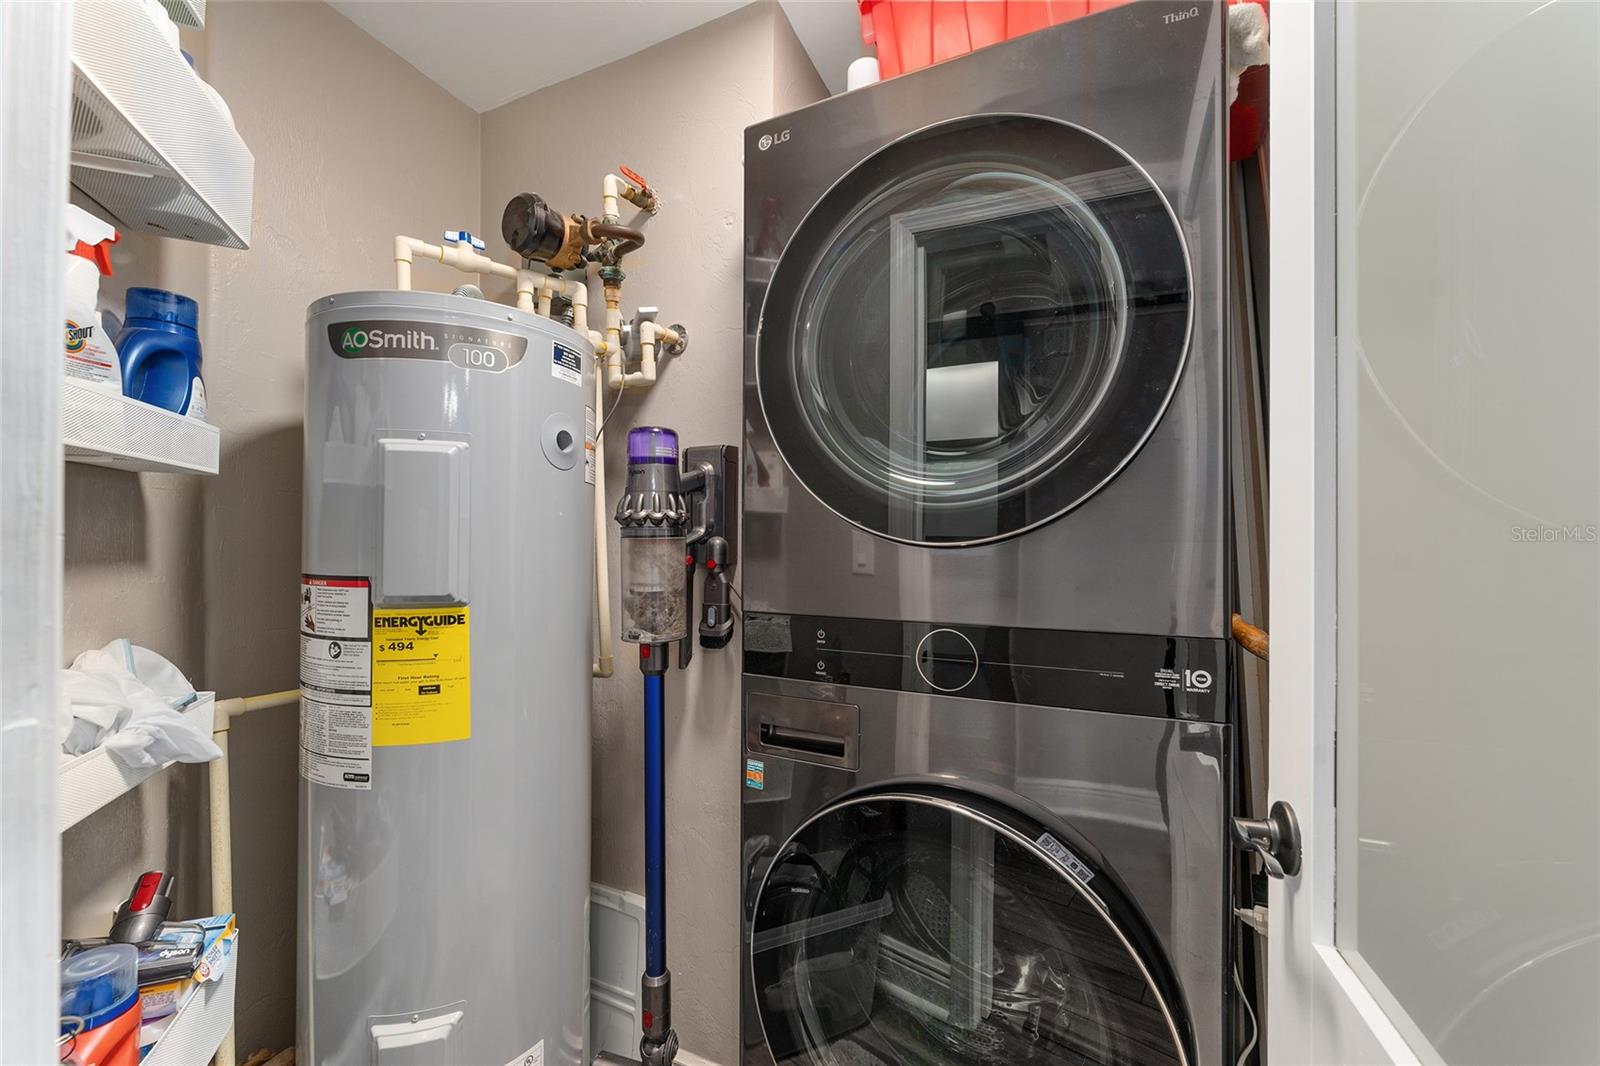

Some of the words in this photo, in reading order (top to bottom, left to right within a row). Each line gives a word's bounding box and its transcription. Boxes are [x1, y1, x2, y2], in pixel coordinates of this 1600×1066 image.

[1163, 7, 1199, 24] ThinQ
[773, 130, 791, 144] LG
[69, 326, 94, 340] SHOUT
[463, 348, 495, 367] 100
[374, 614, 466, 630] ENERGYGUIDE
[388, 641, 414, 652] 494
[160, 948, 190, 958] dyson
